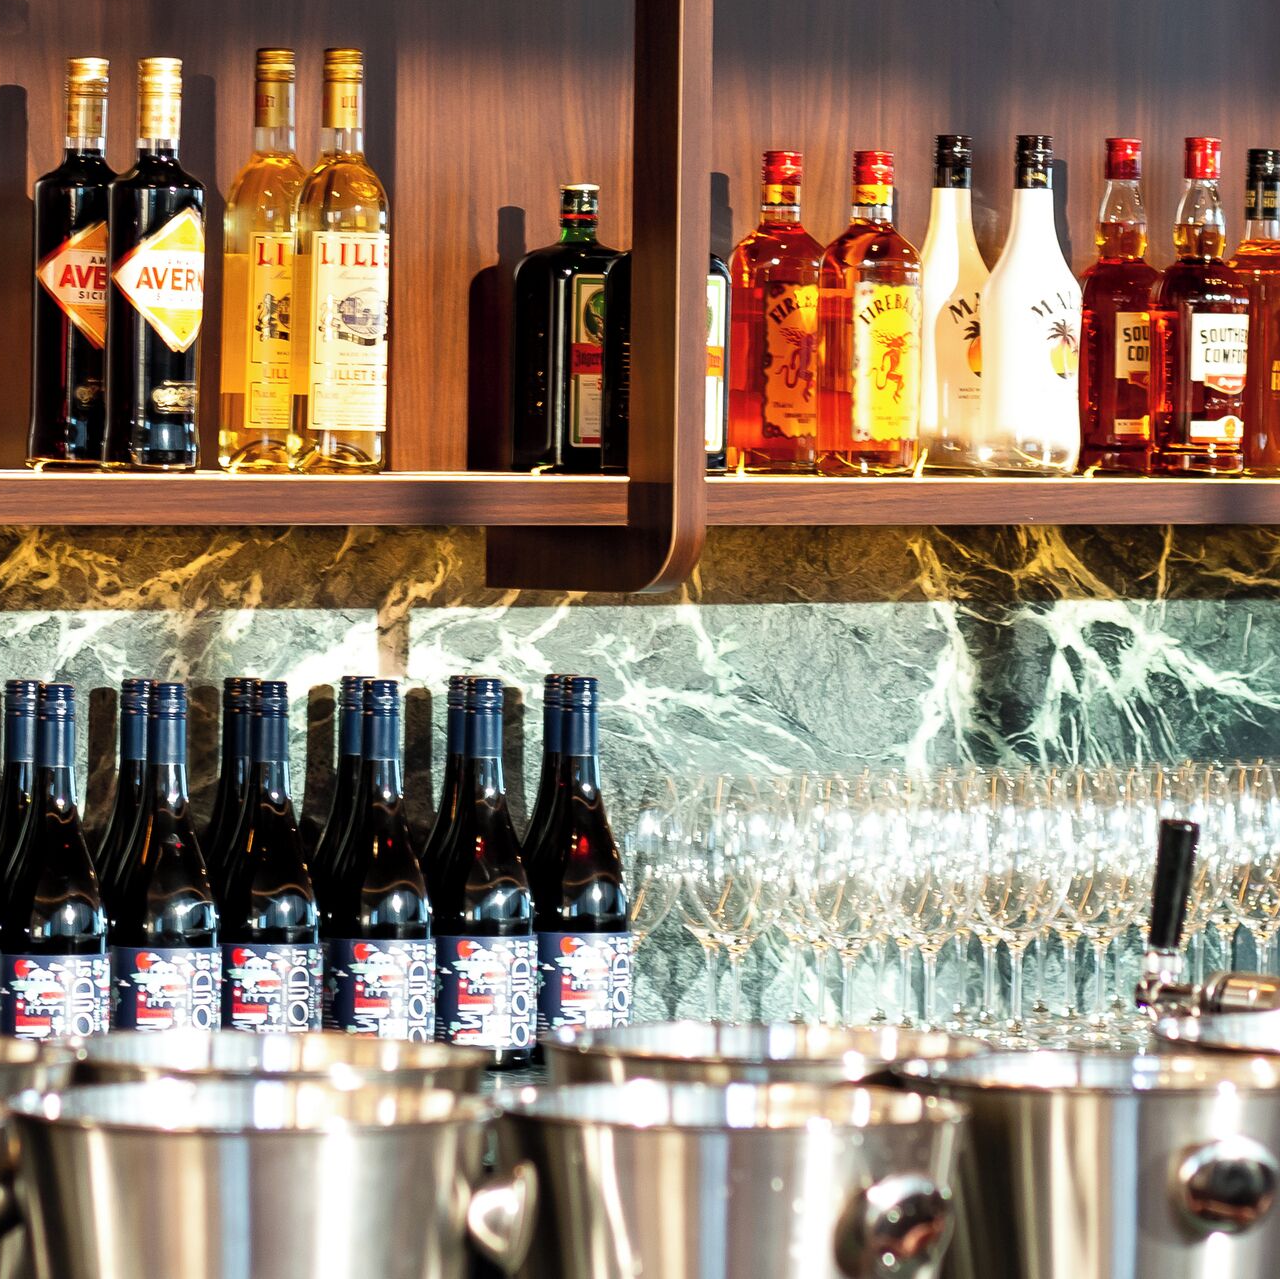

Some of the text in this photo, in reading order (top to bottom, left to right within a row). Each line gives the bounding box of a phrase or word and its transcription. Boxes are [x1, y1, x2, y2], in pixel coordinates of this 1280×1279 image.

[321, 242, 390, 269] LILLE
[58, 264, 107, 291] AVE
[135, 266, 205, 293] AVERN
[1200, 328, 1248, 346] SOUTHER
[1204, 348, 1248, 365] COMFOR
